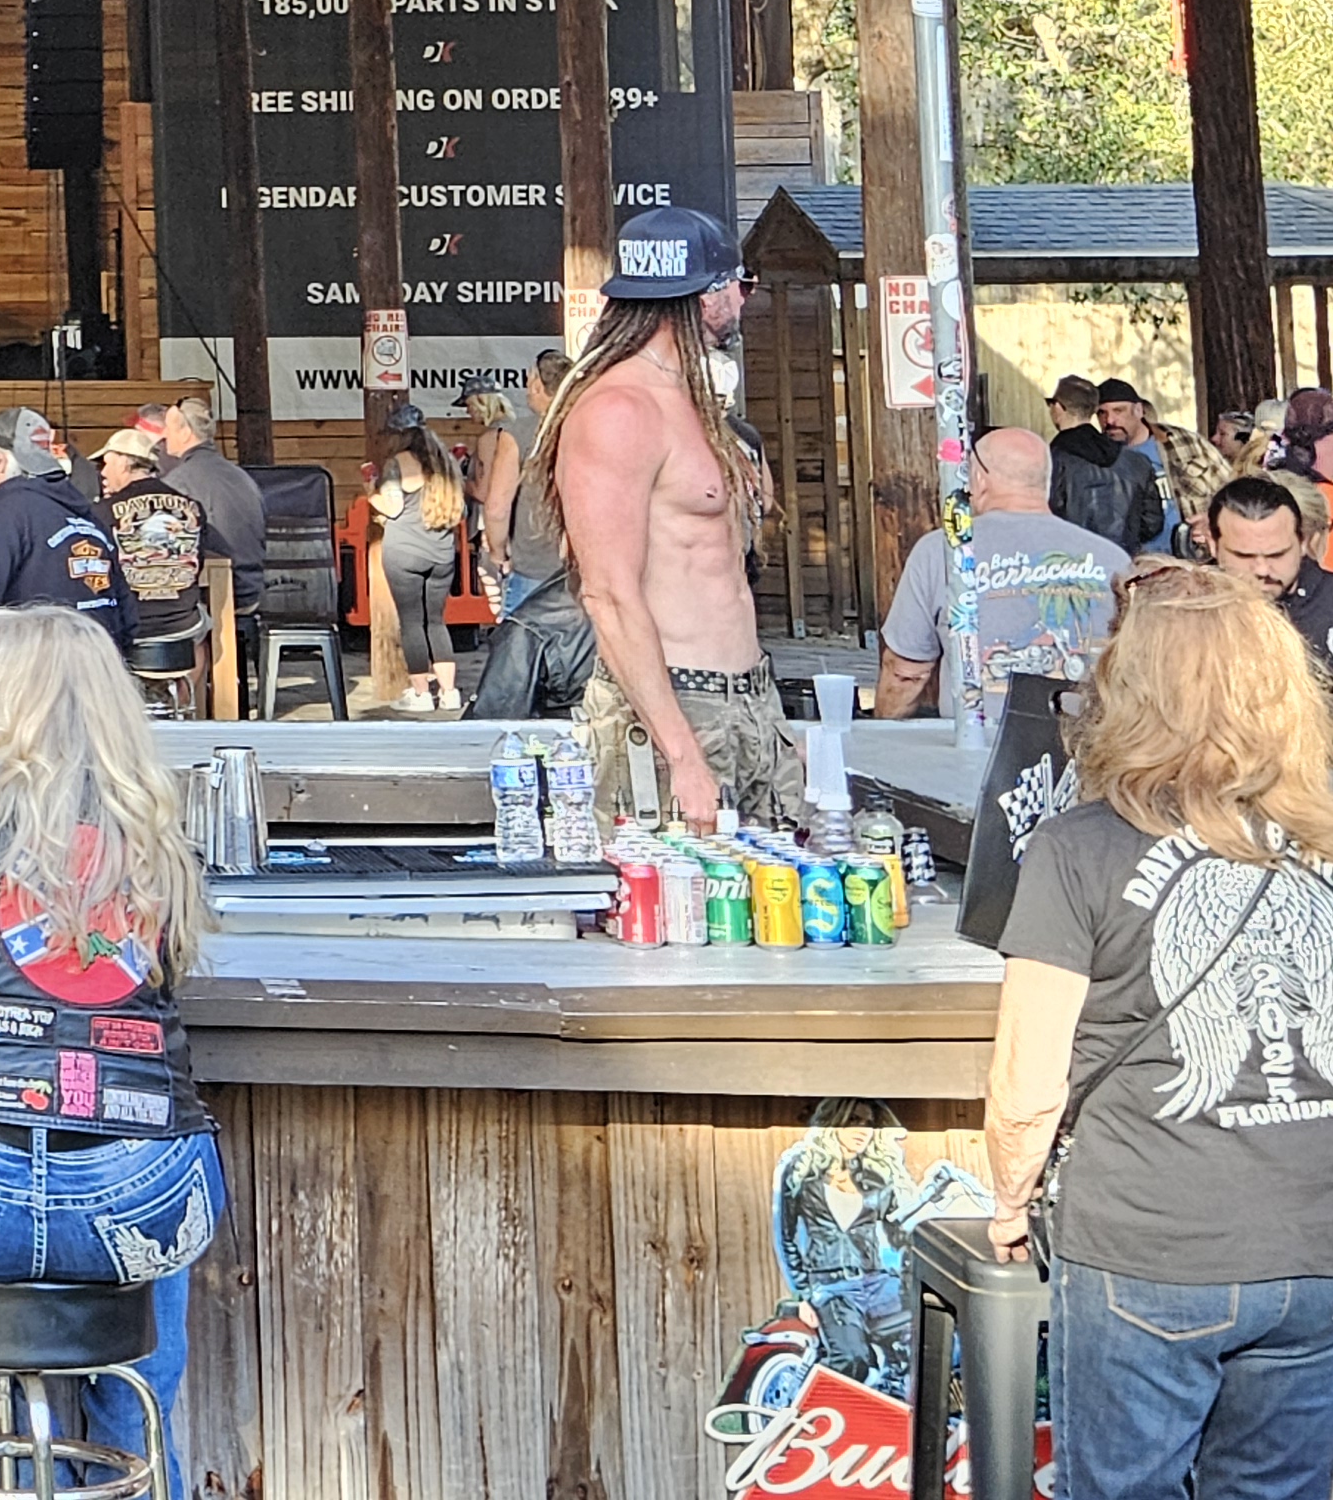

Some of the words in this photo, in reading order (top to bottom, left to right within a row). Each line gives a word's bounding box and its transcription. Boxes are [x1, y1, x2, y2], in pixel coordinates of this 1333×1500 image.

[251, 91, 294, 113] REE
[300, 88, 436, 113] SHING
[443, 88, 483, 111] ON
[490, 87, 562, 111] ORDE
[396, 183, 547, 208] CUSTOMER
[555, 182, 671, 207] SVICE
[618, 238, 689, 260] CHOKING
[621, 255, 687, 278] HAZARD
[306, 281, 360, 305] SAM
[402, 281, 449, 304] DAY
[456, 280, 566, 304] SHIPPIN
[568, 292, 587, 305] NO
[888, 281, 916, 297] NO
[568, 306, 598, 318] CHA
[889, 300, 930, 315] CHA
[974, 552, 1107, 594] Barracuda
[705, 874, 751, 900] prit
[1249, 962, 1298, 1104] 2025
[1216, 1098, 1333, 1129] FLORIDA
